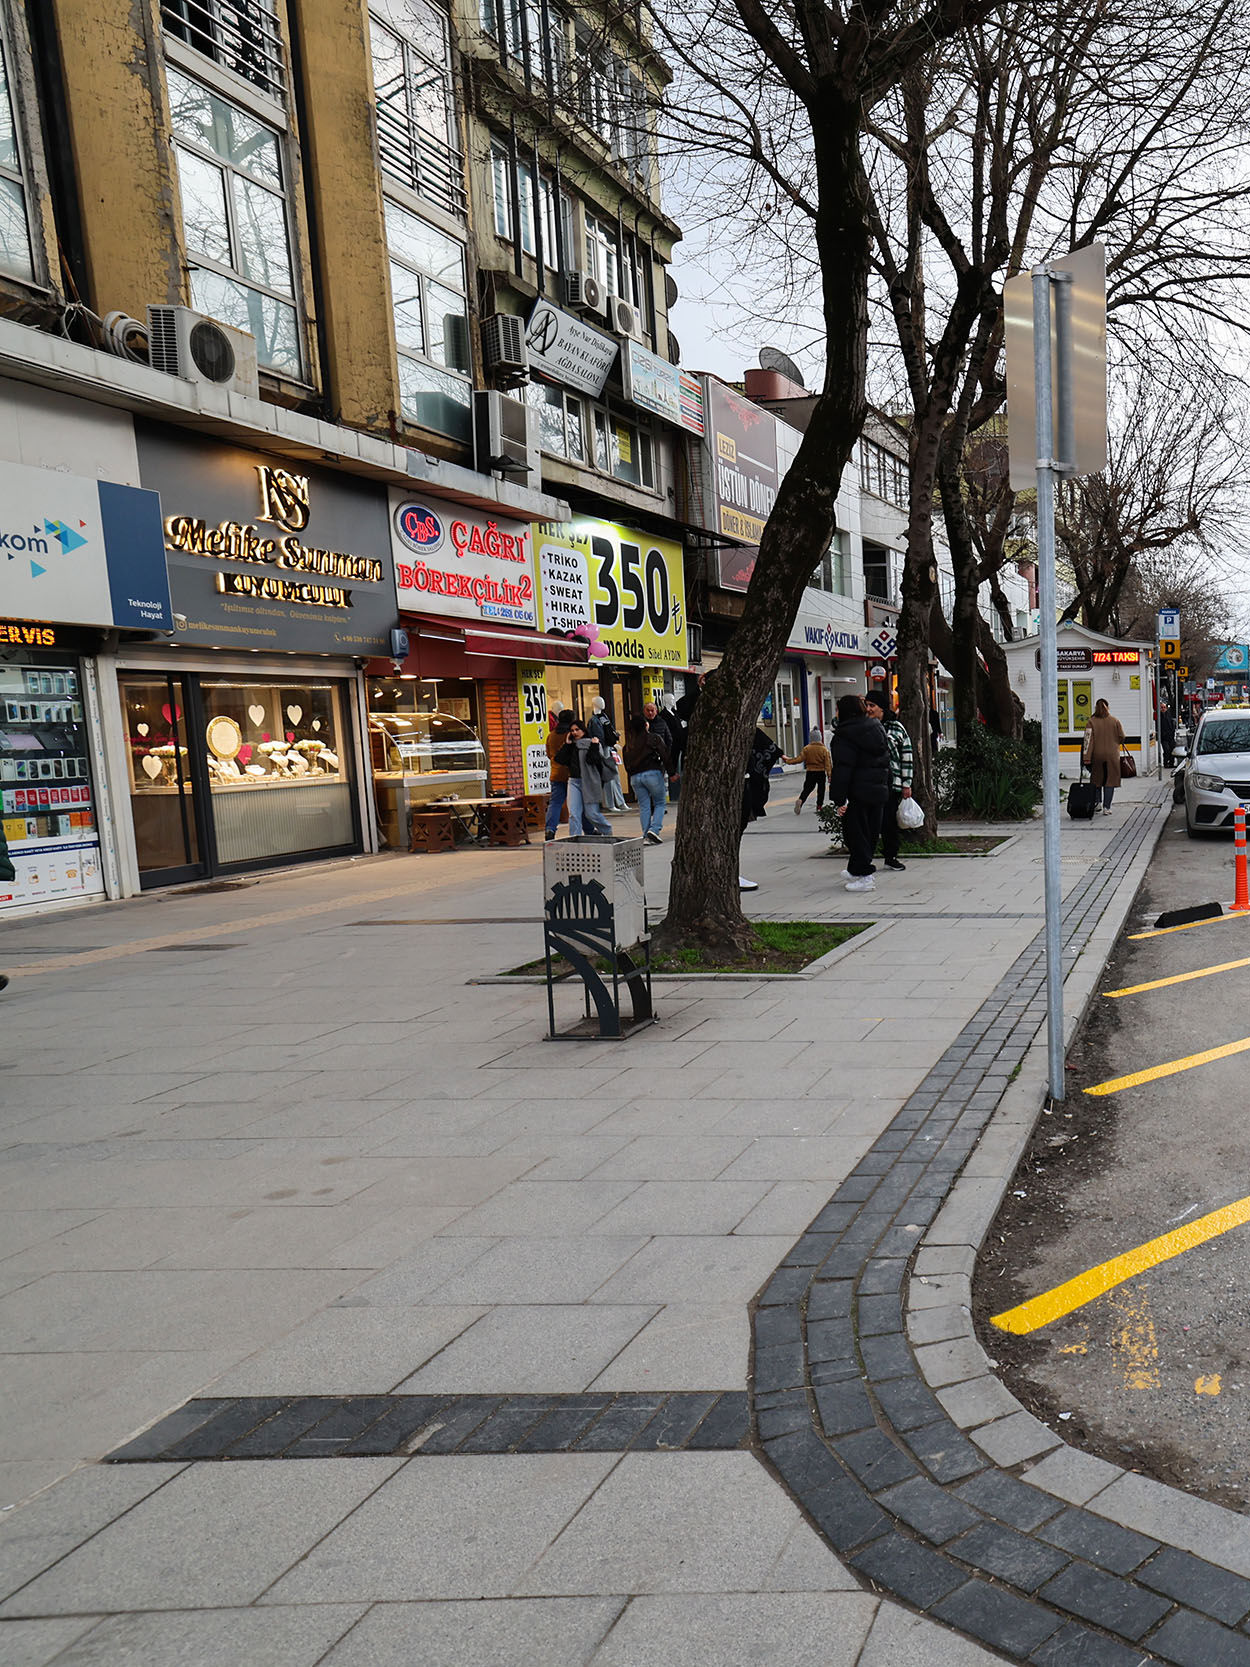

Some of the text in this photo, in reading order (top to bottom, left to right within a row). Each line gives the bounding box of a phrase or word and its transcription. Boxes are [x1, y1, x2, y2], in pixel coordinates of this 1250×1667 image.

[580, 332, 591, 345] Nur
[557, 338, 612, 373] BAYAN KUAFÖRÜ
[555, 356, 577, 374] AĞDA
[576, 365, 601, 386] SALONU
[719, 437, 735, 460] LEZİZ
[718, 458, 776, 516] ÜSTÜN DÖNER
[722, 511, 739, 534] DÖNER
[165, 515, 278, 566] Melike
[450, 520, 526, 564] ÇAĞRI
[547, 553, 578, 569] TRİKO
[548, 569, 583, 585] KAZAK
[592, 535, 670, 635] 350
[550, 585, 583, 600] SWEAT
[128, 598, 162, 611] Teknoloji
[550, 601, 585, 615] HIRKA
[140, 610, 164, 621] Hayat
[514, 609, 524, 619] 05
[524, 611, 534, 621] 06
[804, 626, 858, 650] VAKIF KATILIM
[648, 648, 662, 660] Sibel
[663, 649, 681, 662] AYDIN
[1165, 642, 1175, 655] D
[1093, 652, 1111, 662] 7/24
[522, 684, 547, 724] 350
